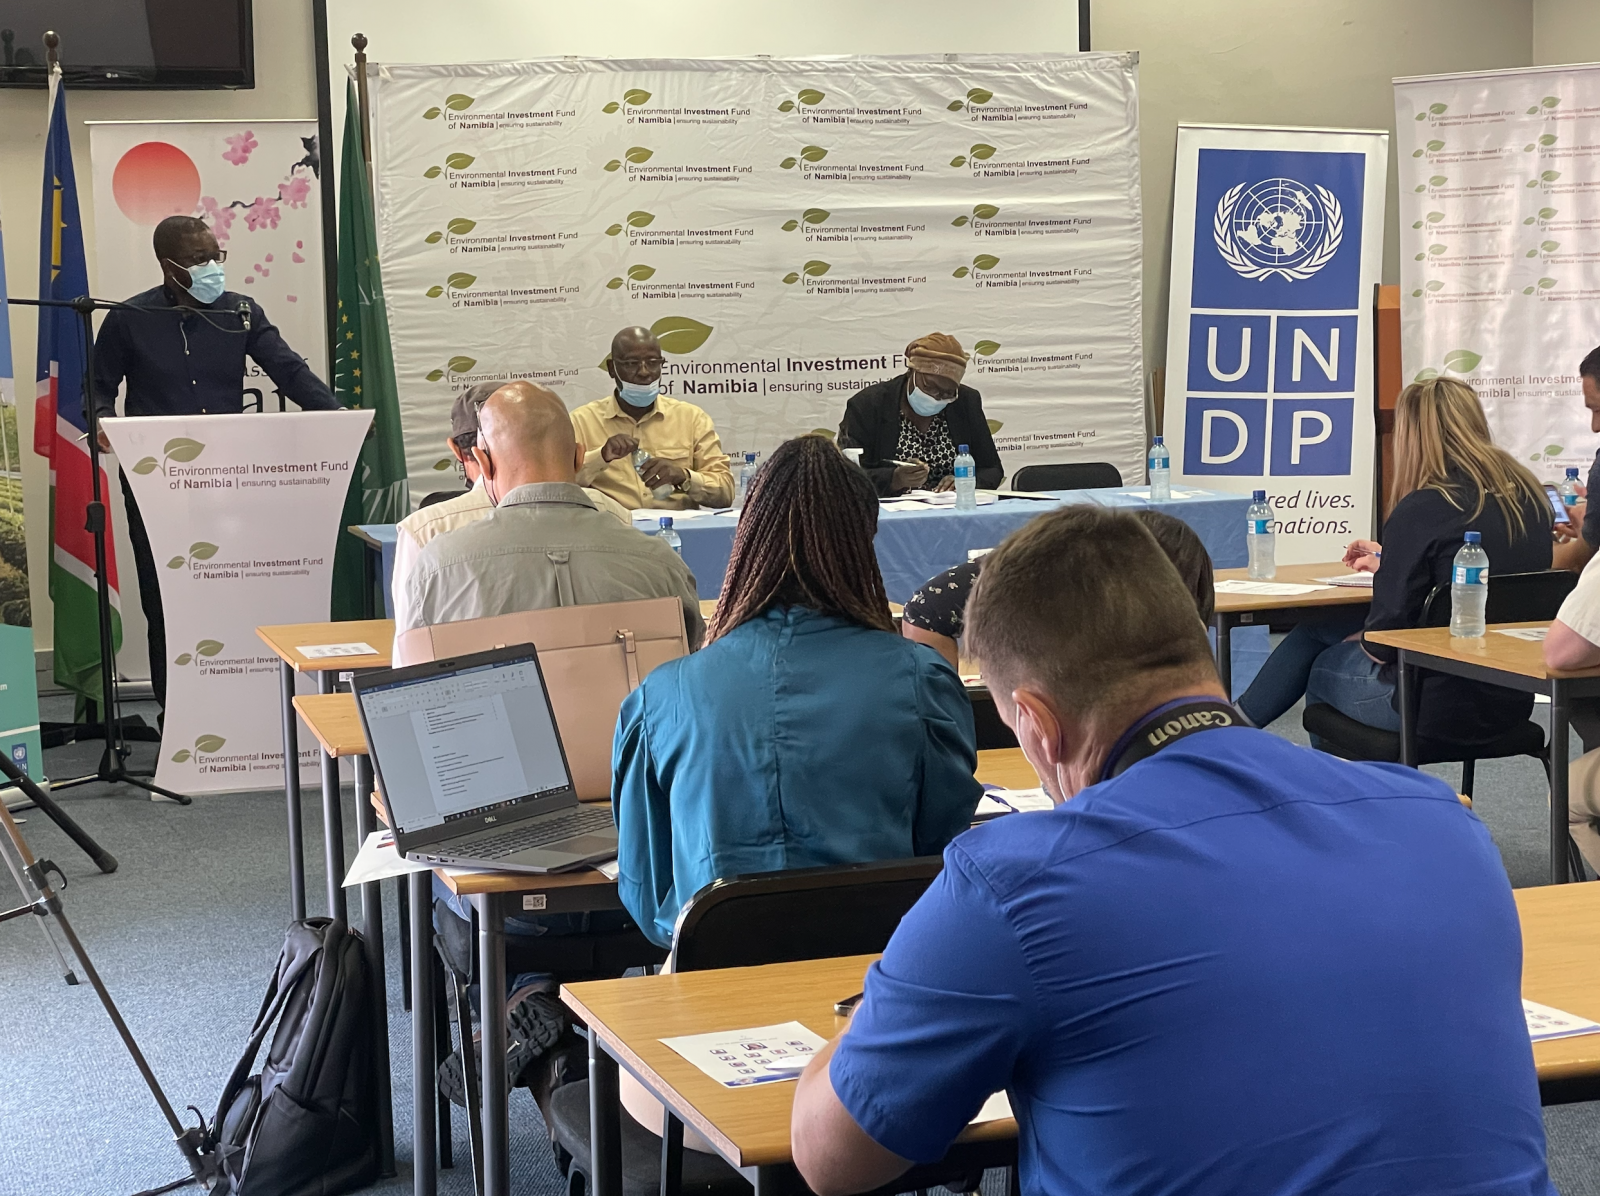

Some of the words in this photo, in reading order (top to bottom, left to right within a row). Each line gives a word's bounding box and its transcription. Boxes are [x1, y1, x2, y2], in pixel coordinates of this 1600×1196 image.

[971, 105, 1022, 113] Environmental
[973, 161, 1025, 169] Environmental
[450, 171, 506, 179] Environmental
[509, 169, 555, 177] Investment
[985, 228, 1016, 236] Namibia
[450, 236, 507, 245] Environmental
[976, 271, 1027, 279] Environmental
[452, 290, 508, 299] Environmental
[511, 287, 557, 295] Investment
[818, 286, 849, 294] Namibia
[661, 358, 780, 375] Environmental
[787, 356, 887, 371] Investment
[978, 357, 1029, 365] Environmental
[451, 373, 507, 382] Environmental
[510, 370, 556, 379] Investment
[1463, 375, 1525, 386] vironmental
[1529, 374, 1582, 384] Investme
[659, 380, 674, 395] of
[684, 379, 757, 394] Namibia
[770, 381, 822, 393] ensuring
[1478, 388, 1510, 398] mibia
[1517, 390, 1553, 398] ensuring
[1033, 432, 1075, 440] Investment
[997, 444, 1022, 452] amibia
[169, 465, 248, 476] Environmental
[253, 463, 317, 473] Investment
[321, 461, 348, 471] Fund
[170, 479, 180, 489] of
[184, 479, 232, 489] Namibia
[279, 477, 330, 485] sustainability
[1306, 490, 1355, 509] lives.
[193, 561, 250, 570] Environmental
[204, 571, 238, 579] Namibia
[200, 657, 254, 666] Environmental
[257, 656, 279, 664] Inves
[1148, 710, 1233, 747] Canon
[199, 753, 259, 763] Environmental
[262, 751, 310, 760] Invesent
[199, 765, 207, 773] of
[210, 764, 246, 772] Namibia
[484, 815, 497, 824] DELL
